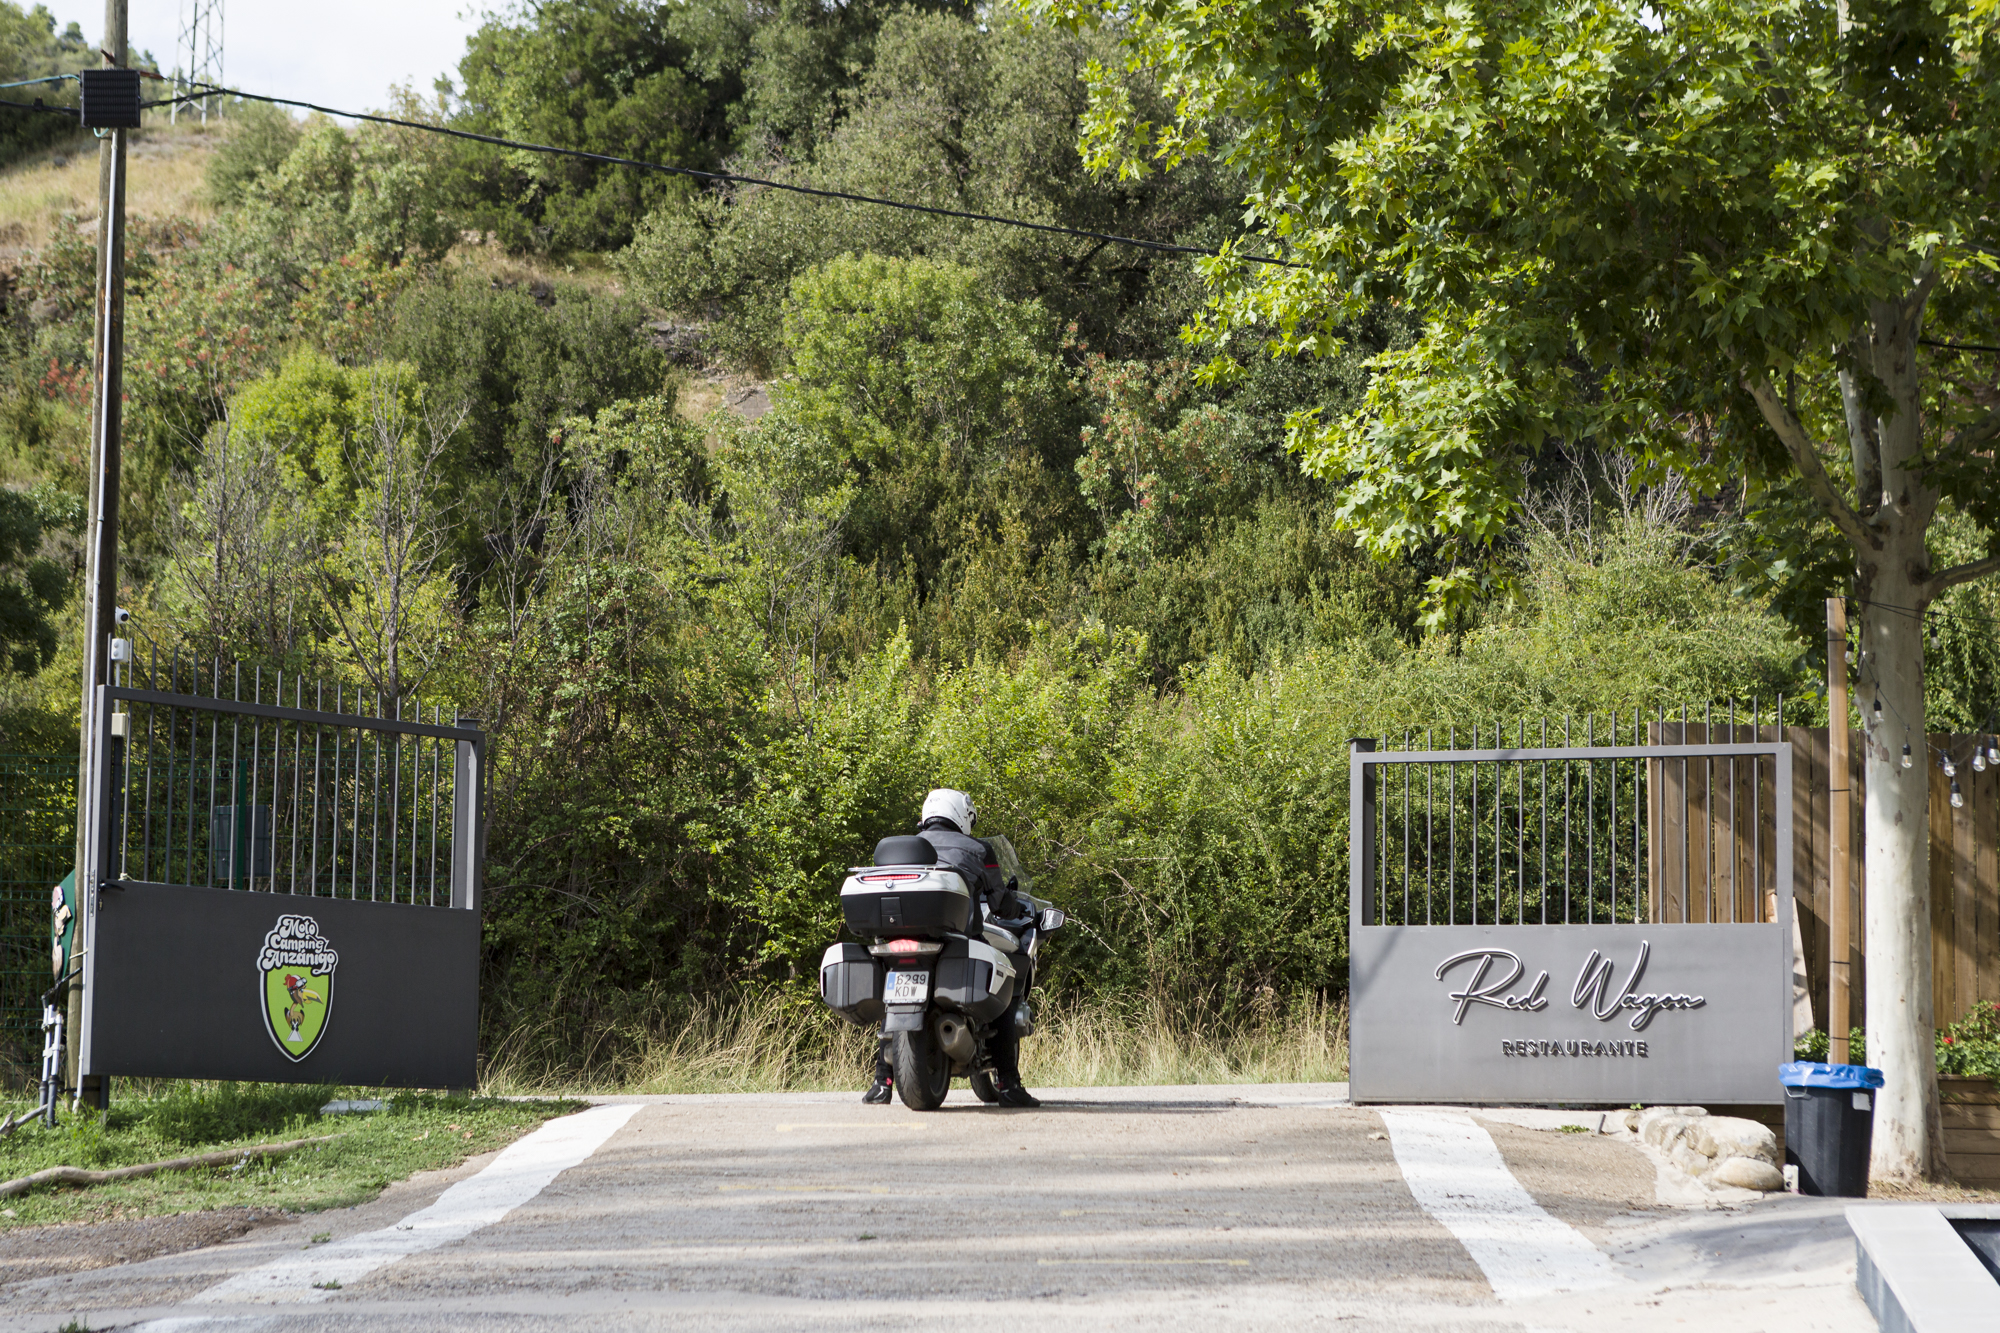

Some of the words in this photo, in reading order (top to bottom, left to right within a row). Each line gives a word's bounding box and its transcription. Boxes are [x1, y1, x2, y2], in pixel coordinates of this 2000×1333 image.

[279, 918, 316, 938] Moto
[270, 934, 324, 953] Camping
[262, 949, 335, 975] Anzánigo
[894, 986, 918, 997] KDW
[1434, 947, 1549, 1025] Red
[1571, 940, 1706, 1030] Wagon
[1501, 1039, 1649, 1057] RESTAURANTE
